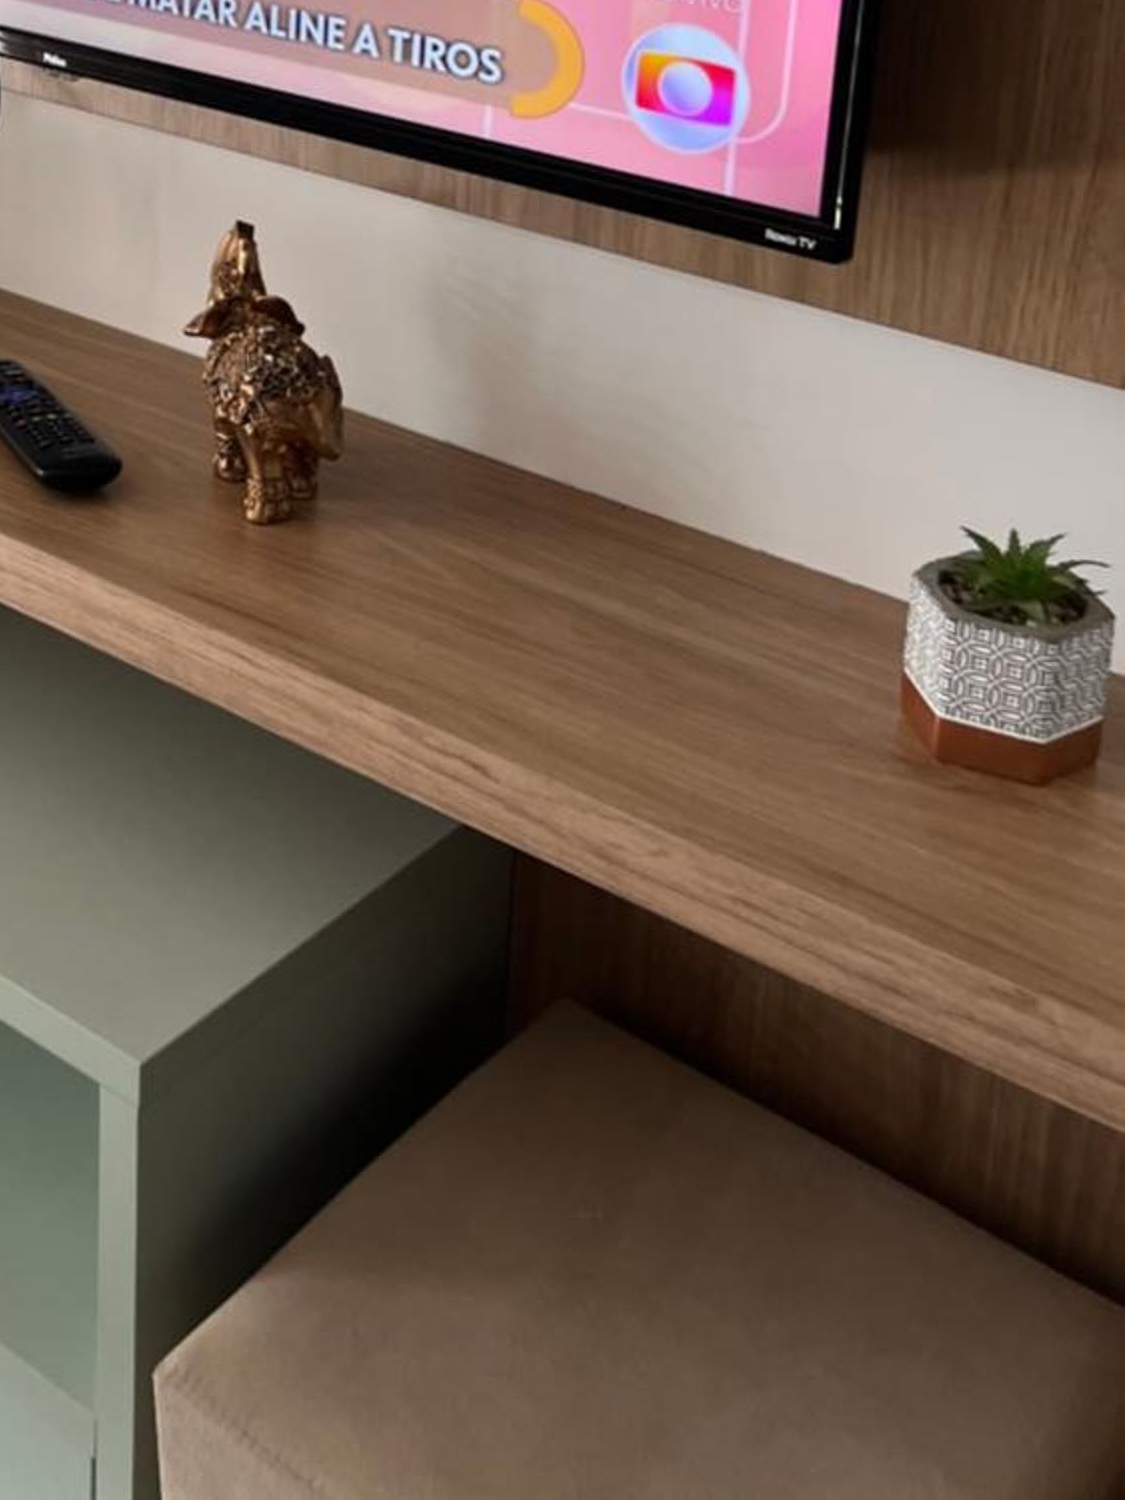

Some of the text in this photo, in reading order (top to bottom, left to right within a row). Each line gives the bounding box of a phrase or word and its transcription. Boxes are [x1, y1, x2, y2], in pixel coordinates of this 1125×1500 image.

[244, 1, 347, 50] ALINE
[352, 23, 380, 59] A
[386, 27, 504, 84] TIROS
[799, 235, 818, 251] TV
